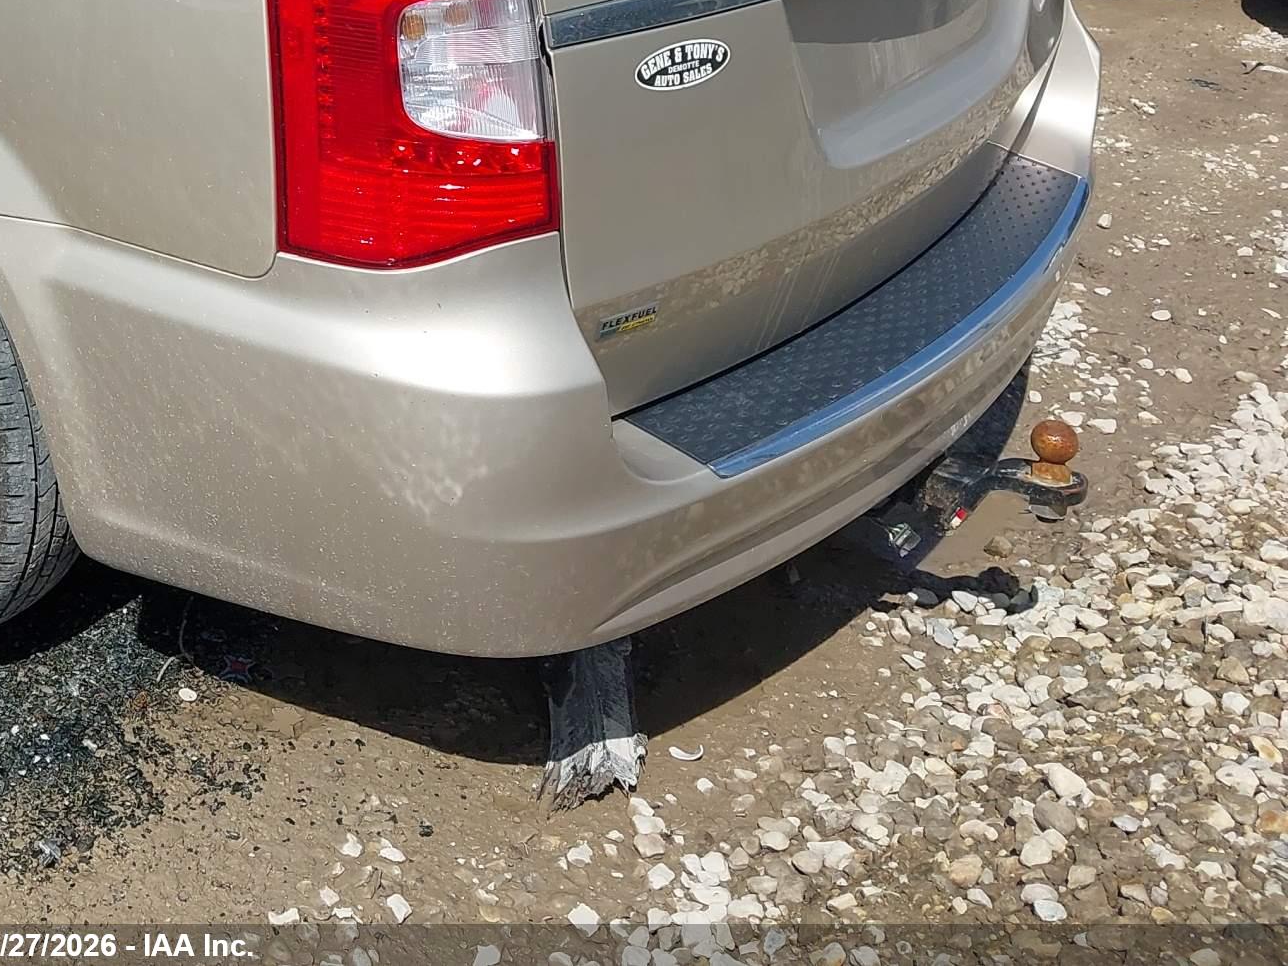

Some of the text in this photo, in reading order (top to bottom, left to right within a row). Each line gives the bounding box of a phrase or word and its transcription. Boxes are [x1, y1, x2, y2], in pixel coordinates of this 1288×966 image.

[640, 43, 725, 80] GENE & TONY'S
[668, 59, 700, 74] DEMOTTE
[654, 62, 713, 87] AUTO SALES
